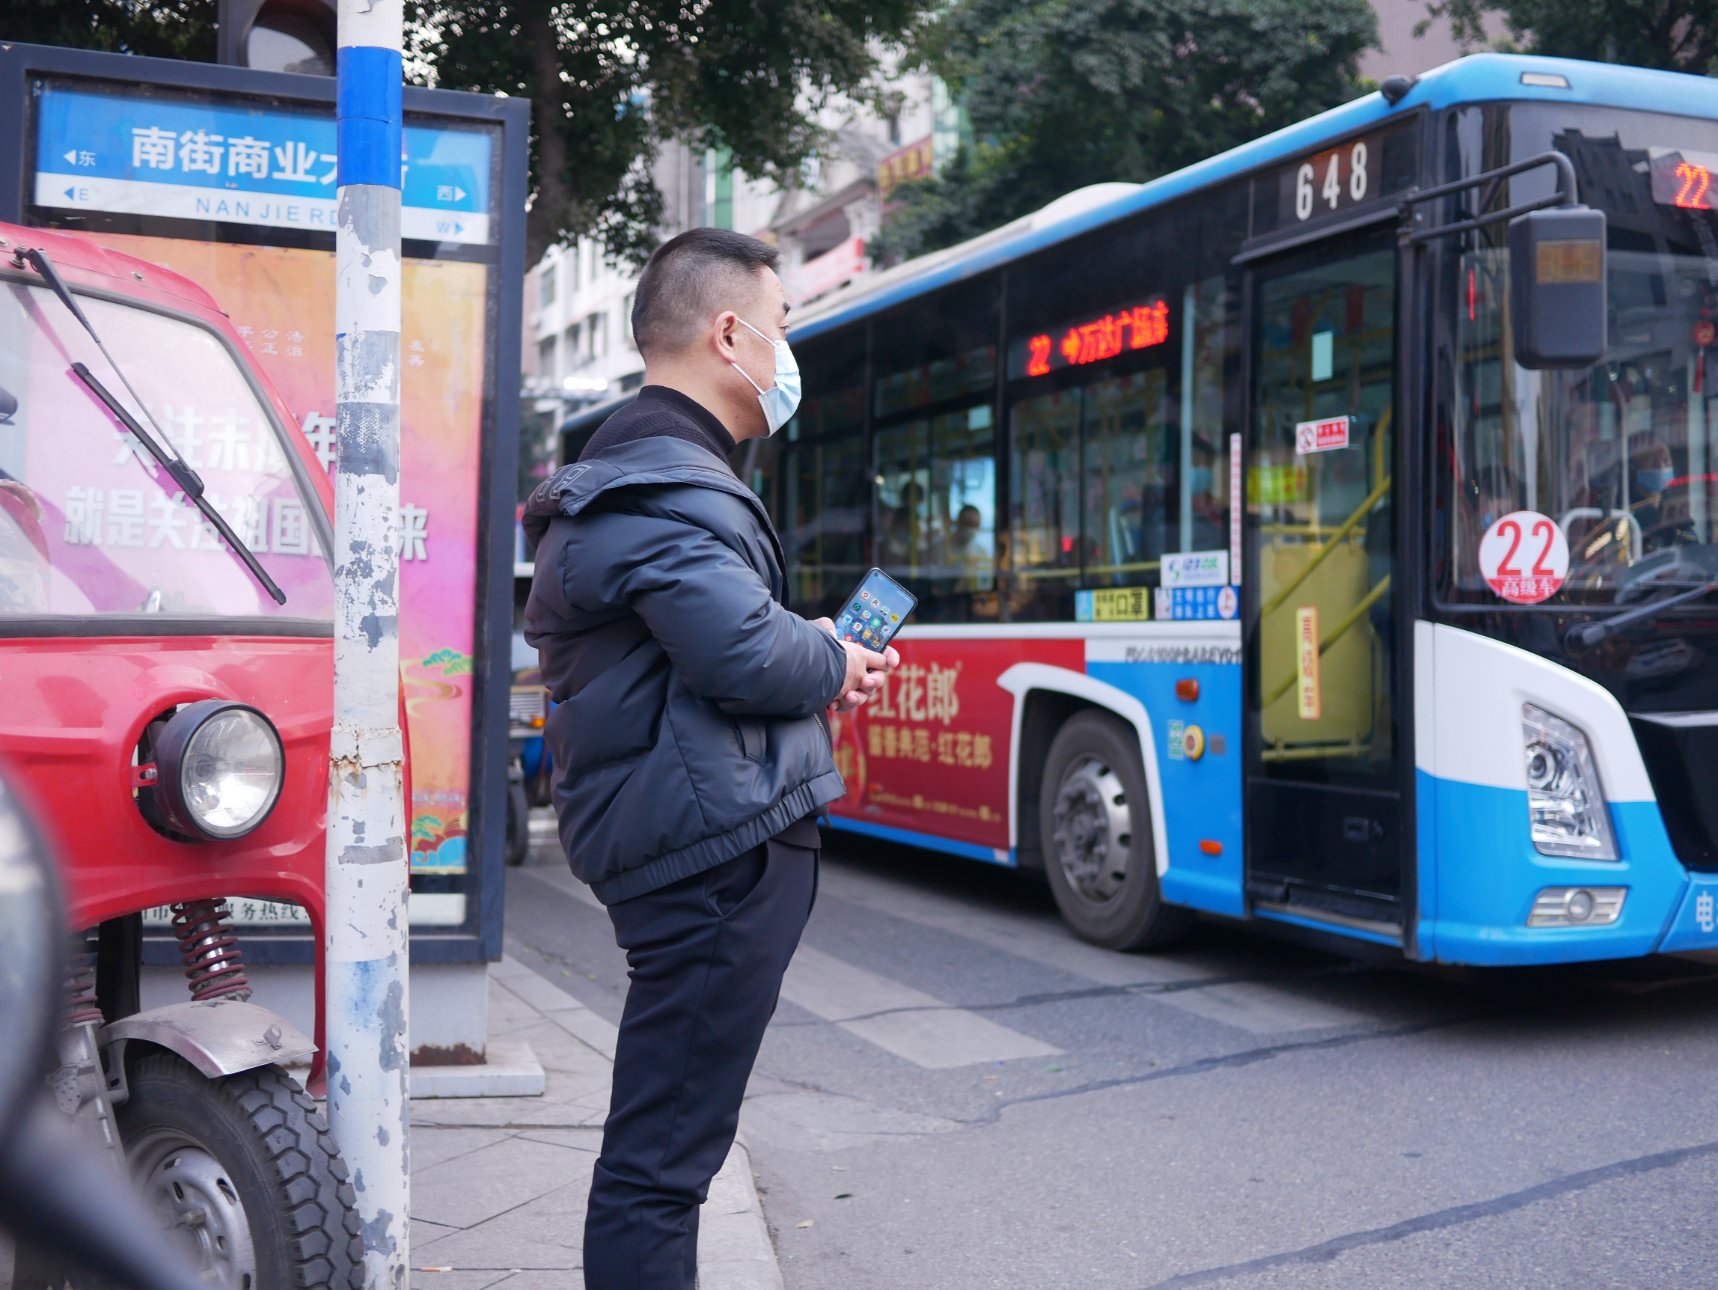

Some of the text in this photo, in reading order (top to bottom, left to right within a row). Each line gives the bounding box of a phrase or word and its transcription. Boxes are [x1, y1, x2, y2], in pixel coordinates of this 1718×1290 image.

[79, 150, 96, 166] 东
[132, 127, 408, 189] 南街商业
[80, 188, 89, 201] E
[437, 186, 453, 201] 西
[1296, 141, 1368, 221] 648
[1676, 162, 1711, 209] 22
[196, 197, 250, 216] NAN
[260, 203, 300, 221] JIE
[437, 221, 452, 235] W
[1028, 334, 1051, 376] 22
[63, 485, 429, 562] 就是关注祖国来
[1496, 520, 1555, 576] 22
[1696, 890, 1718, 933] 电
